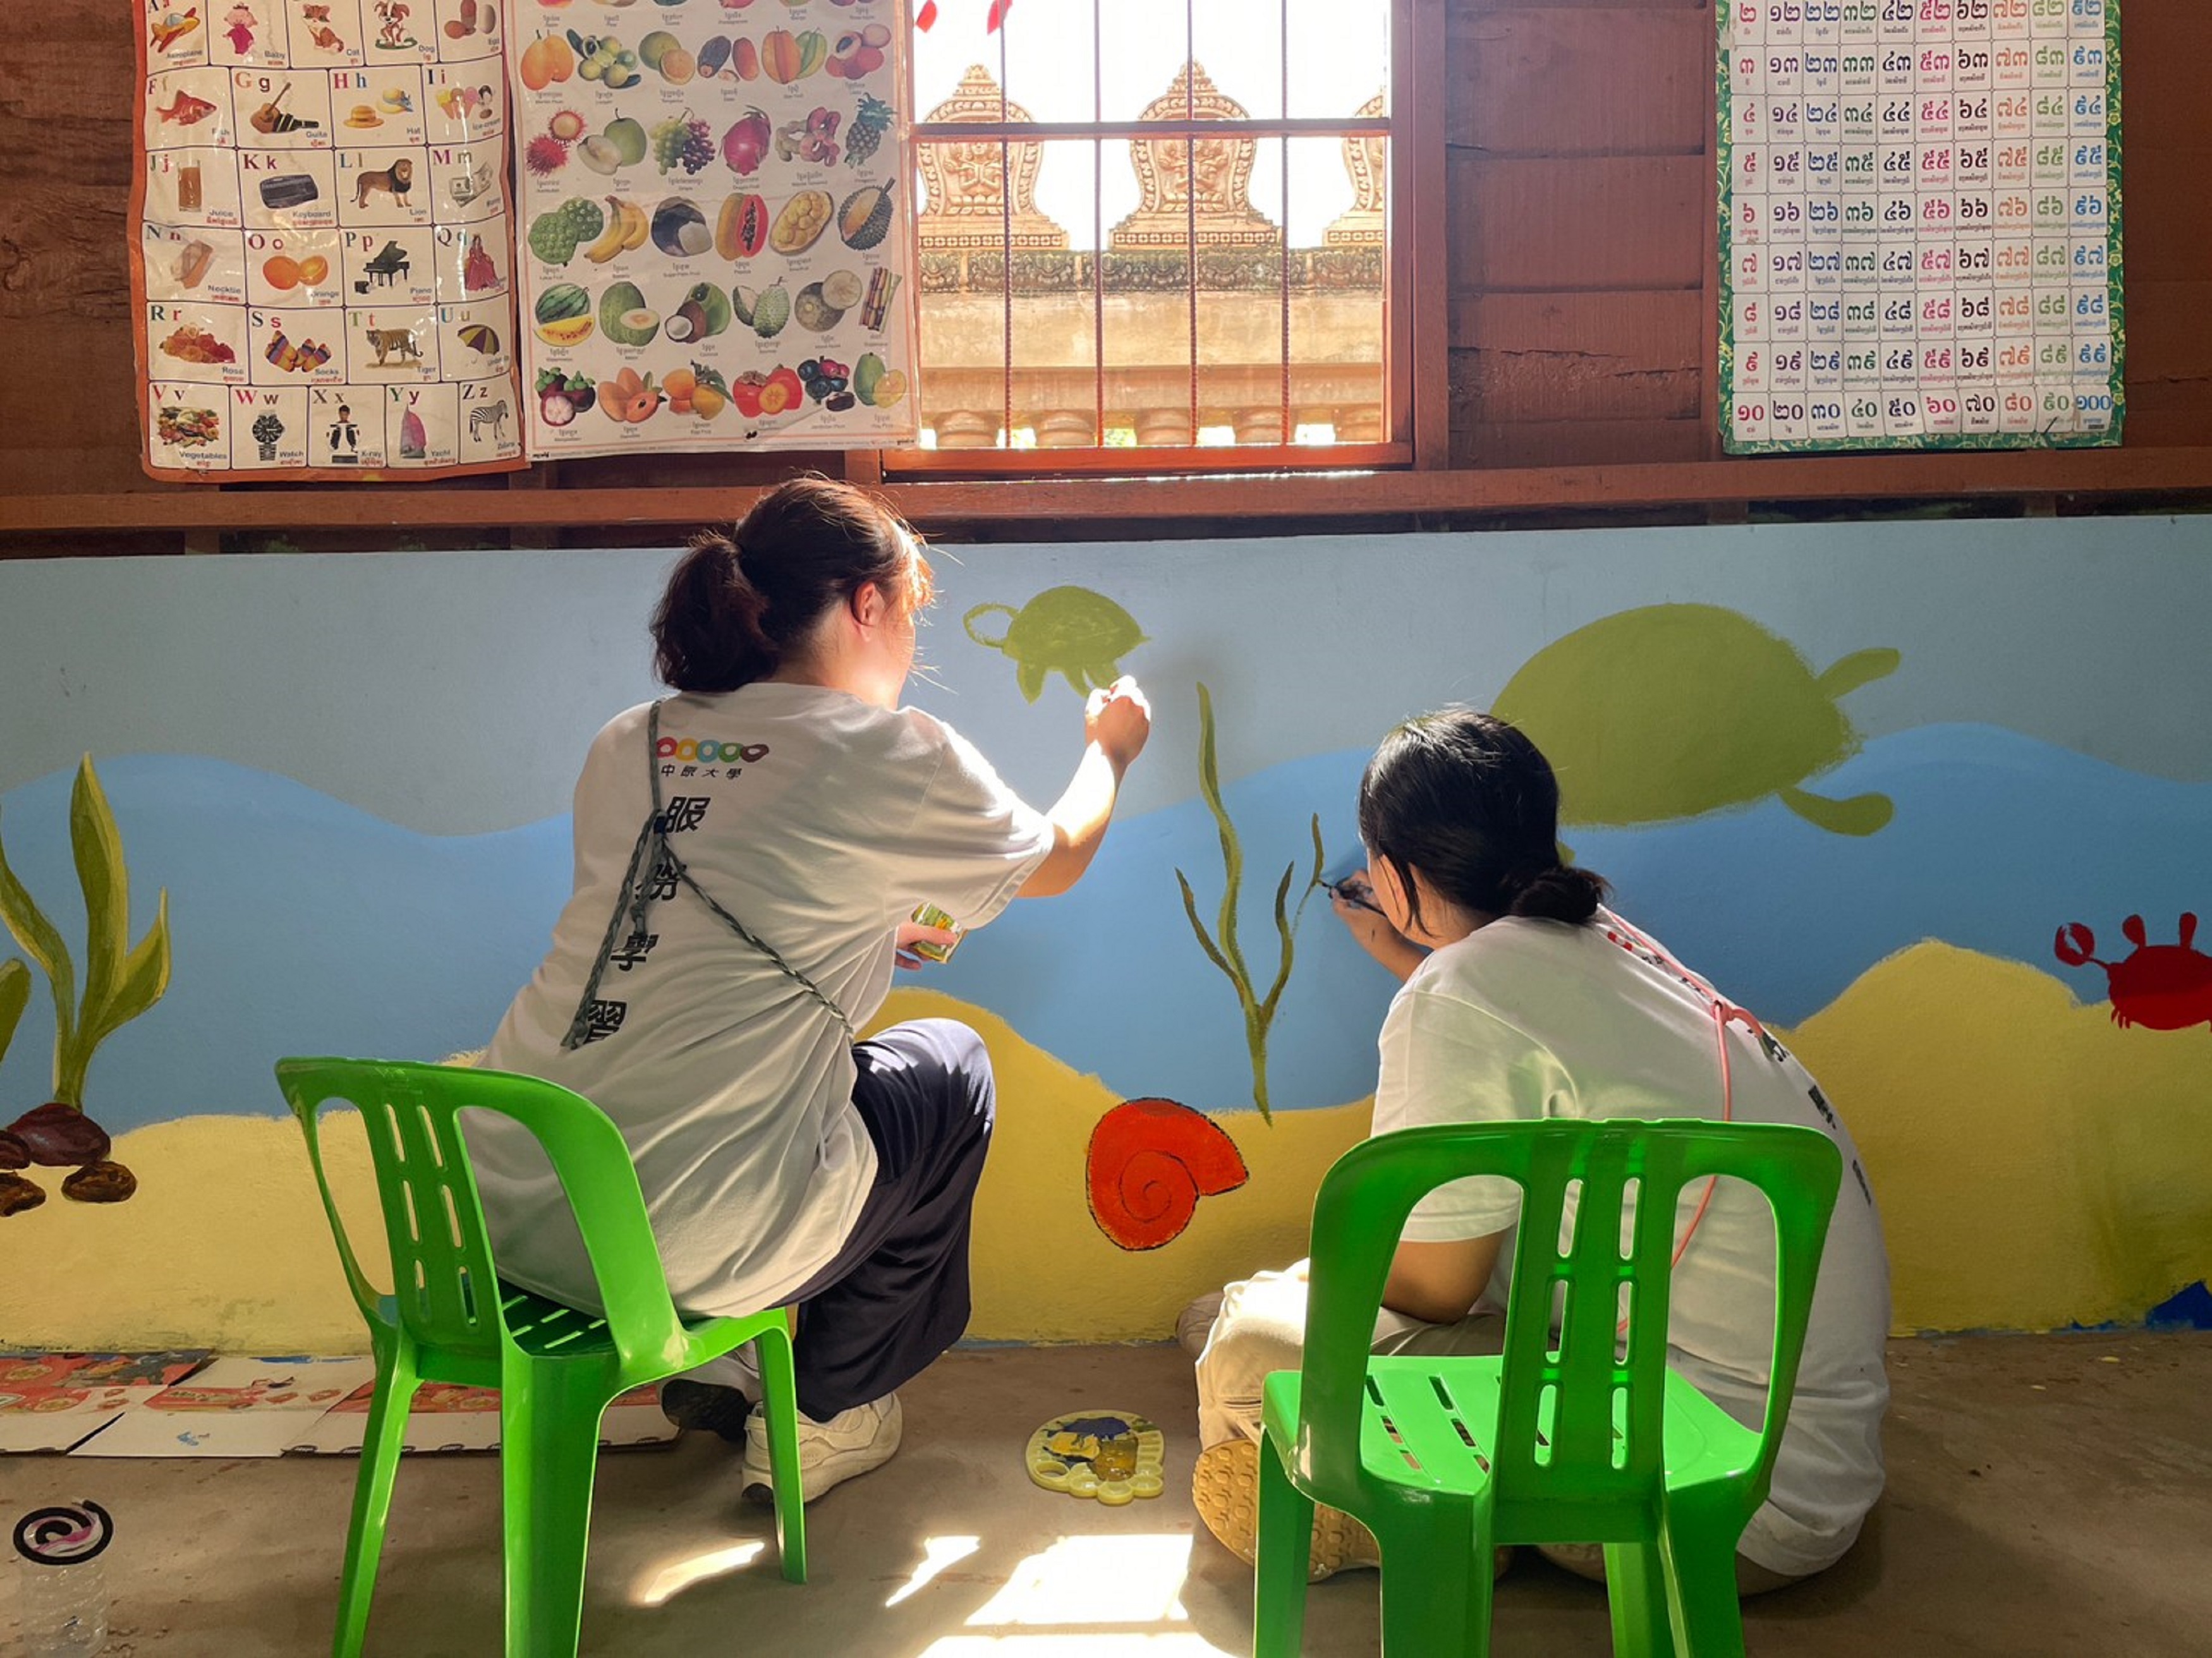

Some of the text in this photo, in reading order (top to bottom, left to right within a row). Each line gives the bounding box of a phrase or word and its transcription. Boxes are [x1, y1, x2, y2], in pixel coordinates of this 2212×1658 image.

[1740, 2, 1756, 22] ២
[1770, 1, 1800, 21] ១២
[1806, 1, 1840, 21] ២២
[1844, 0, 1875, 21] ៣២
[1883, 0, 1912, 20] ៤២
[1920, 0, 1951, 20] ៥២
[1957, 0, 1988, 20] ៦២
[1993, 0, 2027, 18] ៧២
[2033, 0, 2065, 17] ៨២
[2072, 0, 2101, 15] ៩២
[1806, 53, 1837, 72] ២៣
[1883, 51, 1911, 71] ៤៣
[1920, 51, 1949, 71] ៥៣
[1959, 49, 1988, 69] ៦៣
[1996, 47, 2027, 66] ៧៣
[2036, 45, 2064, 64] ៨៣
[2074, 46, 2102, 64] ៩៣
[1740, 57, 1754, 74] ៣
[1770, 57, 1798, 73] ១៣
[1843, 57, 1874, 72] ៣៣
[149, 79, 157, 95] F
[236, 72, 270, 92] G g
[334, 73, 367, 88] H h
[1744, 103, 1754, 123] ៤
[1773, 103, 1797, 123] ១៤
[1807, 103, 1837, 123] ២៤
[1845, 102, 1872, 122] ៣៤
[1883, 102, 1909, 121] ៤៤
[1922, 100, 1948, 120] ៥៤
[1960, 99, 1986, 118] ៦៤
[1997, 97, 2027, 117] ៧៤
[2037, 95, 2063, 115] ៨៤
[2075, 95, 2101, 114] ៩៤
[243, 154, 276, 169] K k
[340, 154, 352, 167] L
[433, 150, 472, 165] M m
[1744, 152, 1756, 172] ៥
[1774, 152, 1799, 171] ១៥
[1808, 152, 1837, 171] ២៥
[1845, 152, 1873, 171] ៣៥
[1884, 151, 1910, 171] ៤៥
[1922, 150, 1949, 170] ៥៥
[1960, 148, 1987, 168] ៦៥
[1998, 147, 2027, 167] ៧៥
[2037, 145, 2063, 166] ៨៥
[2075, 145, 2101, 165] ៩៥
[1743, 203, 1754, 223] ៦
[1774, 202, 1799, 221] ១៦
[1809, 201, 1838, 221] ២៦
[1846, 202, 1873, 221] ៣៦
[1885, 200, 1911, 221] ៤៦
[1923, 199, 1950, 219] ៥៦
[1961, 198, 1988, 217] ៦៦
[1998, 197, 2027, 216] ៧៦
[2037, 196, 2063, 215] ៨៦
[2075, 195, 2101, 215] ៩៦
[147, 225, 180, 240] N n
[249, 234, 284, 250] O o
[345, 232, 373, 251] P p
[437, 228, 452, 246] Q
[1742, 253, 1756, 272] ៧
[1773, 251, 1802, 271] ១៧
[1809, 251, 1840, 270] ២៧
[1845, 251, 1875, 270] ៣៧
[1883, 251, 1912, 270] ៤៧
[1922, 249, 1950, 269] ៥៧
[1959, 248, 1989, 268] ៦៧
[1997, 246, 2029, 267] ៧៧
[2037, 245, 2065, 265] ៨៧
[2074, 245, 2103, 265] ៩៧
[151, 306, 181, 321] R r
[1745, 302, 1756, 322] ៨
[1775, 301, 1801, 320] ១៨
[1810, 301, 1839, 320] ២៨
[1847, 301, 1874, 320] ៣៨
[1885, 301, 1911, 320] ៤៨
[1923, 299, 1950, 319] ៥៨
[1962, 297, 1989, 317] ៦៨
[2000, 296, 2029, 315] ៧៨
[2039, 295, 2065, 314] ៨៨
[2077, 294, 2103, 314] ៩៨
[252, 311, 281, 328] S s
[349, 312, 375, 327] T t
[441, 308, 470, 323] U u
[1746, 351, 1758, 372] ៩
[1776, 351, 1801, 370] ១៩
[1811, 351, 1840, 370] ២៩
[1847, 351, 1875, 370] ៣៩
[1887, 349, 1912, 369] ៤៩
[1924, 348, 1950, 368] ៥៩
[1962, 347, 1988, 368] ៦៩
[2000, 345, 2029, 366] ៧៩
[2041, 344, 2067, 363] ៨៩
[2079, 343, 2106, 363] ៩៩
[153, 385, 185, 401] V v
[236, 389, 278, 405] W w
[313, 389, 344, 404] X x
[390, 387, 420, 404] Y y
[463, 384, 488, 399] Z z
[1773, 401, 1803, 420] ២០
[1852, 399, 1877, 417] ៤០
[1888, 398, 1916, 417] ៥០
[1926, 396, 1955, 413] ៦០
[1966, 394, 1995, 412] ៧០
[2005, 393, 2032, 411] ៨០
[2043, 392, 2069, 411] ៩០
[2076, 395, 2112, 411] ១០០
[1738, 404, 1764, 421] ១០
[1811, 404, 1840, 419] ៣០
[179, 451, 227, 459] Vegetables
